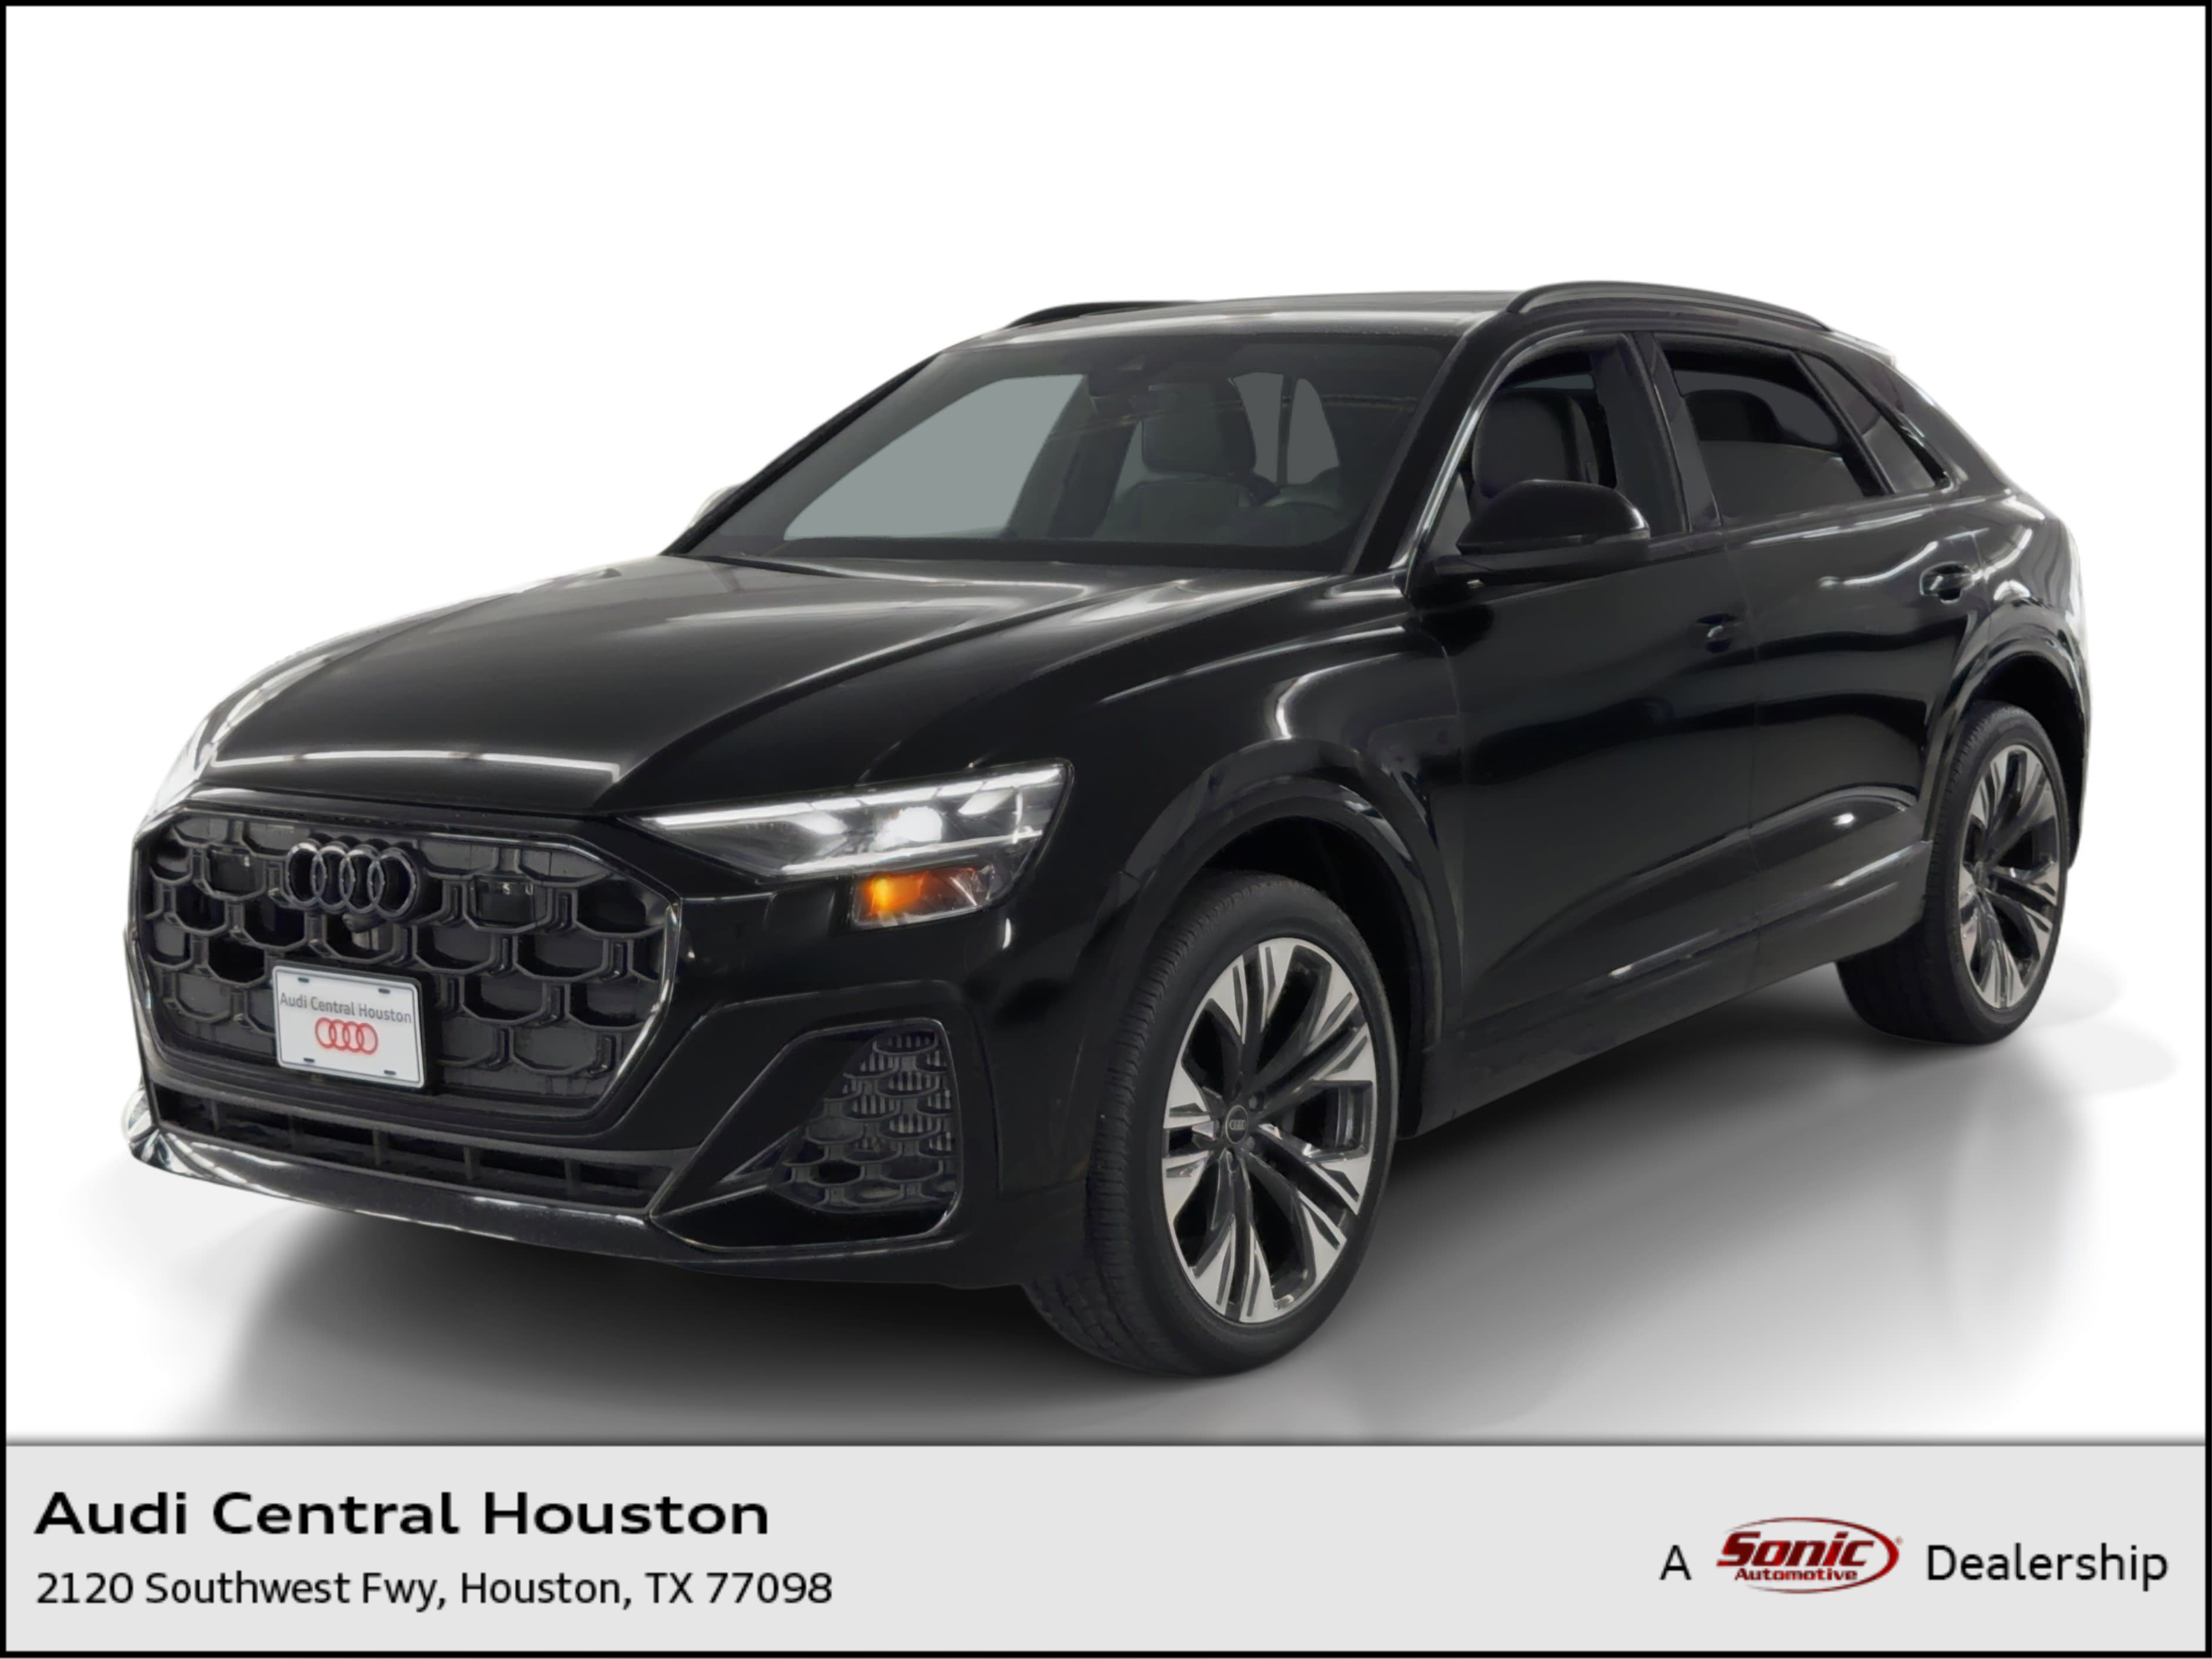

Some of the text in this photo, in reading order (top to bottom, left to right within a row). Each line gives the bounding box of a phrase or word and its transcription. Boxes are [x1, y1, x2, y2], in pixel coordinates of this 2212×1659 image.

[280, 992, 411, 1023] Audi Central Houston
